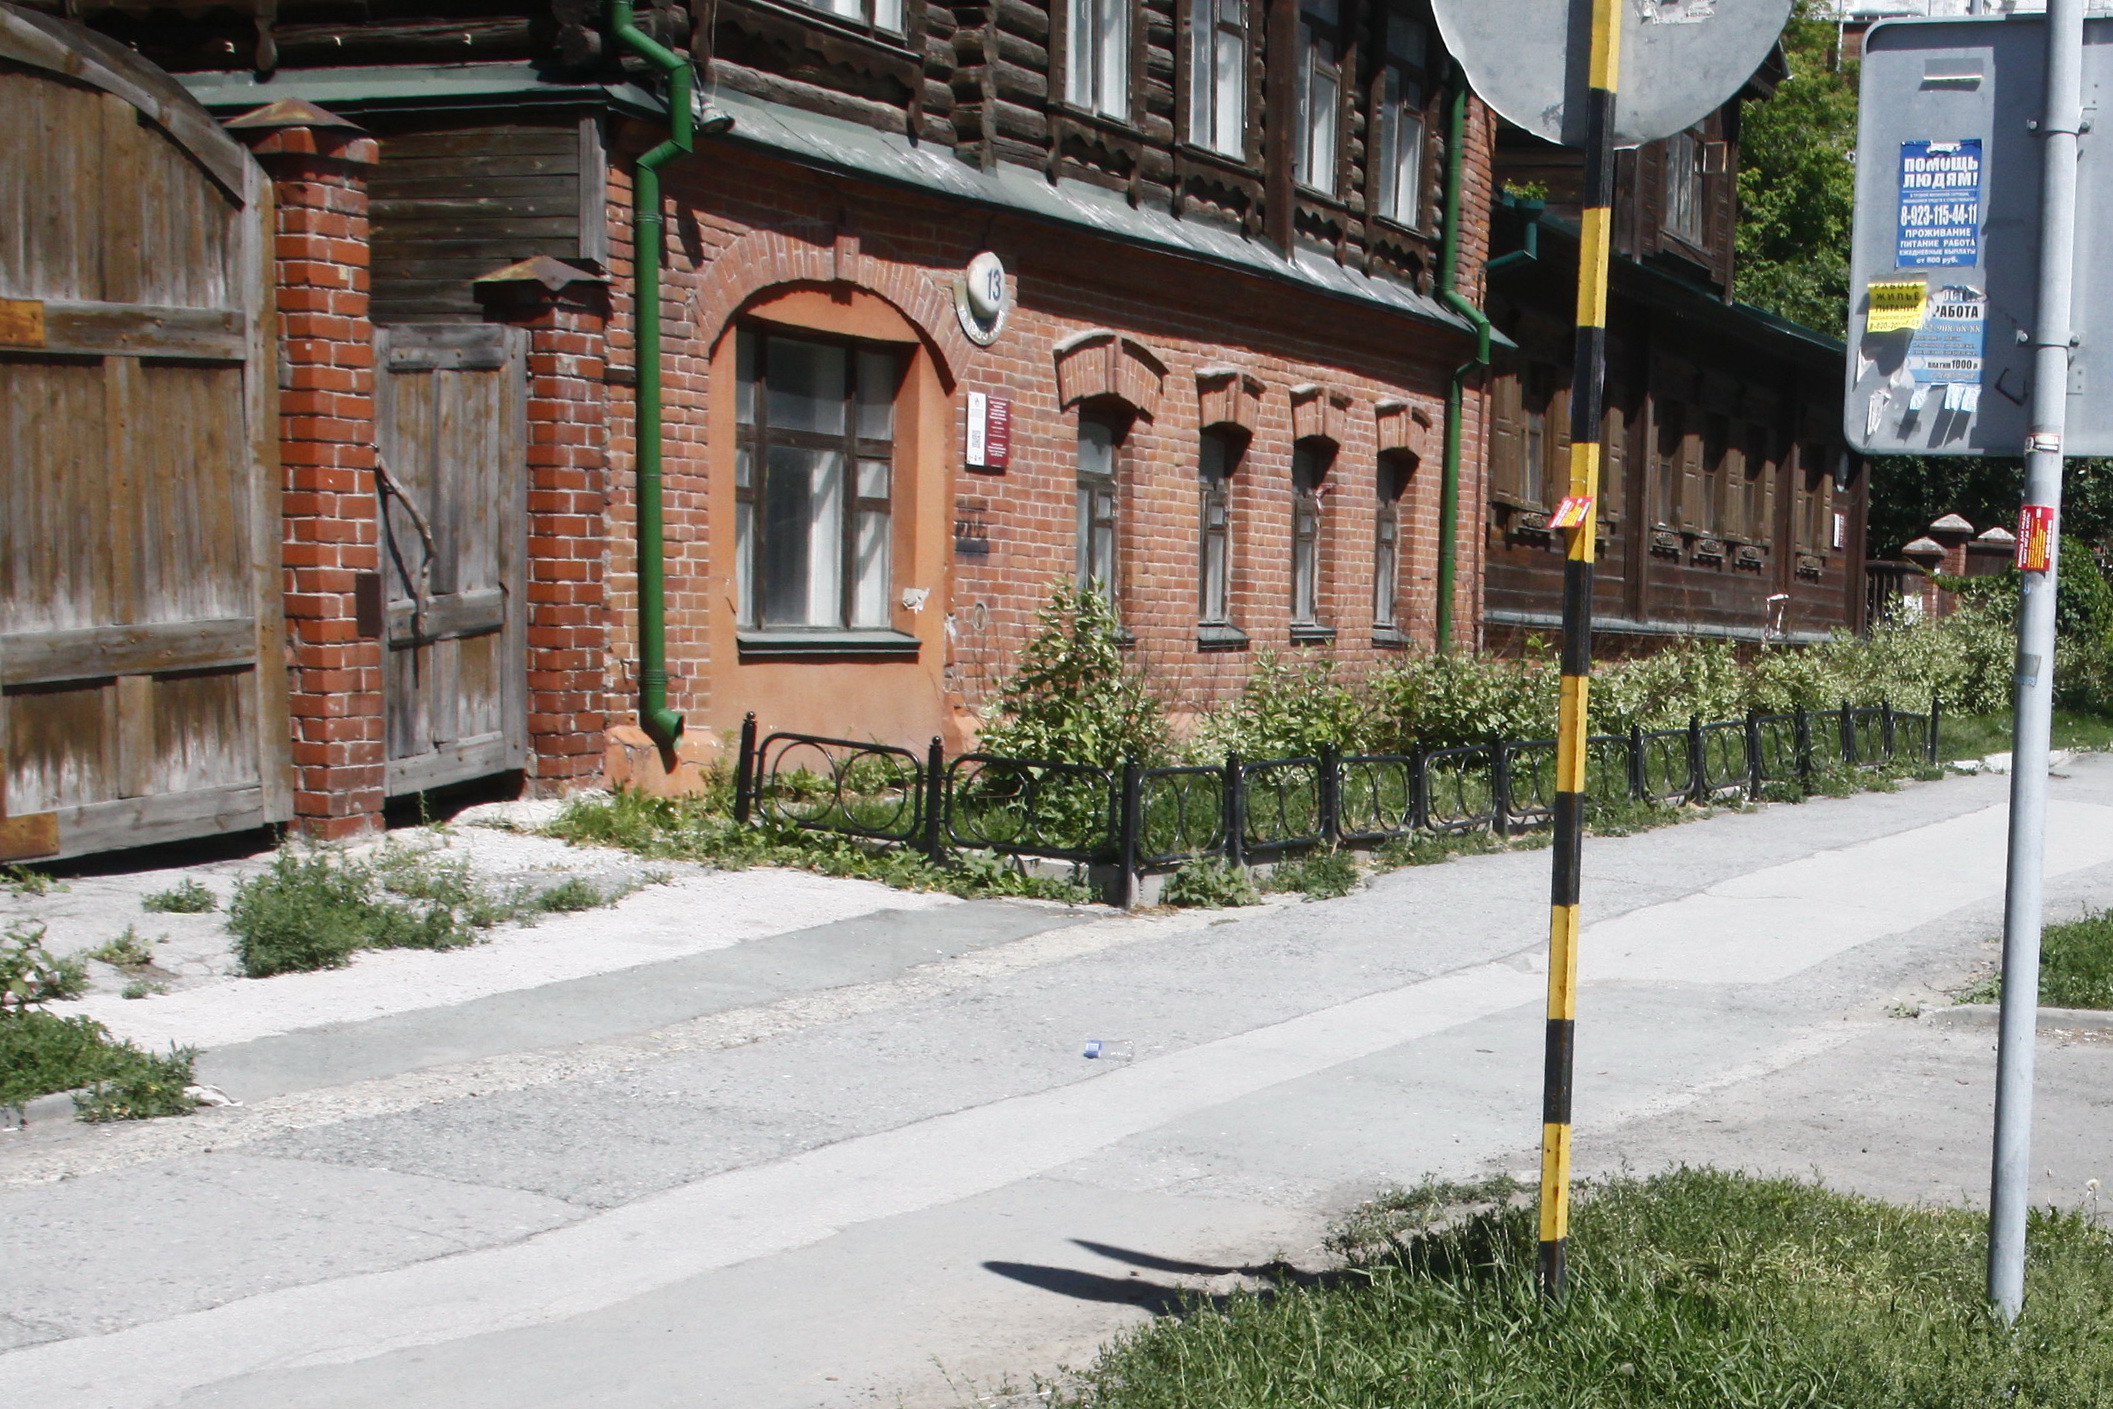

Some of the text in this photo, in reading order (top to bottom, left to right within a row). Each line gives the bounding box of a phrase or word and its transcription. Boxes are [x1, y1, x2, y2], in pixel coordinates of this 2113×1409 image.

[1904, 156, 1979, 173] ПОМОЩЬ
[1903, 172, 1978, 189] ЛЮДЯМ!
[1901, 204, 1977, 226] 8-923-115-44-11
[1905, 228, 1972, 238] ПРОЖИВАНИЕ
[1900, 238, 1976, 248] ПИТАНИЕ РАБОТА
[988, 268, 1001, 302] 13
[1951, 359, 1973, 369] 1000
